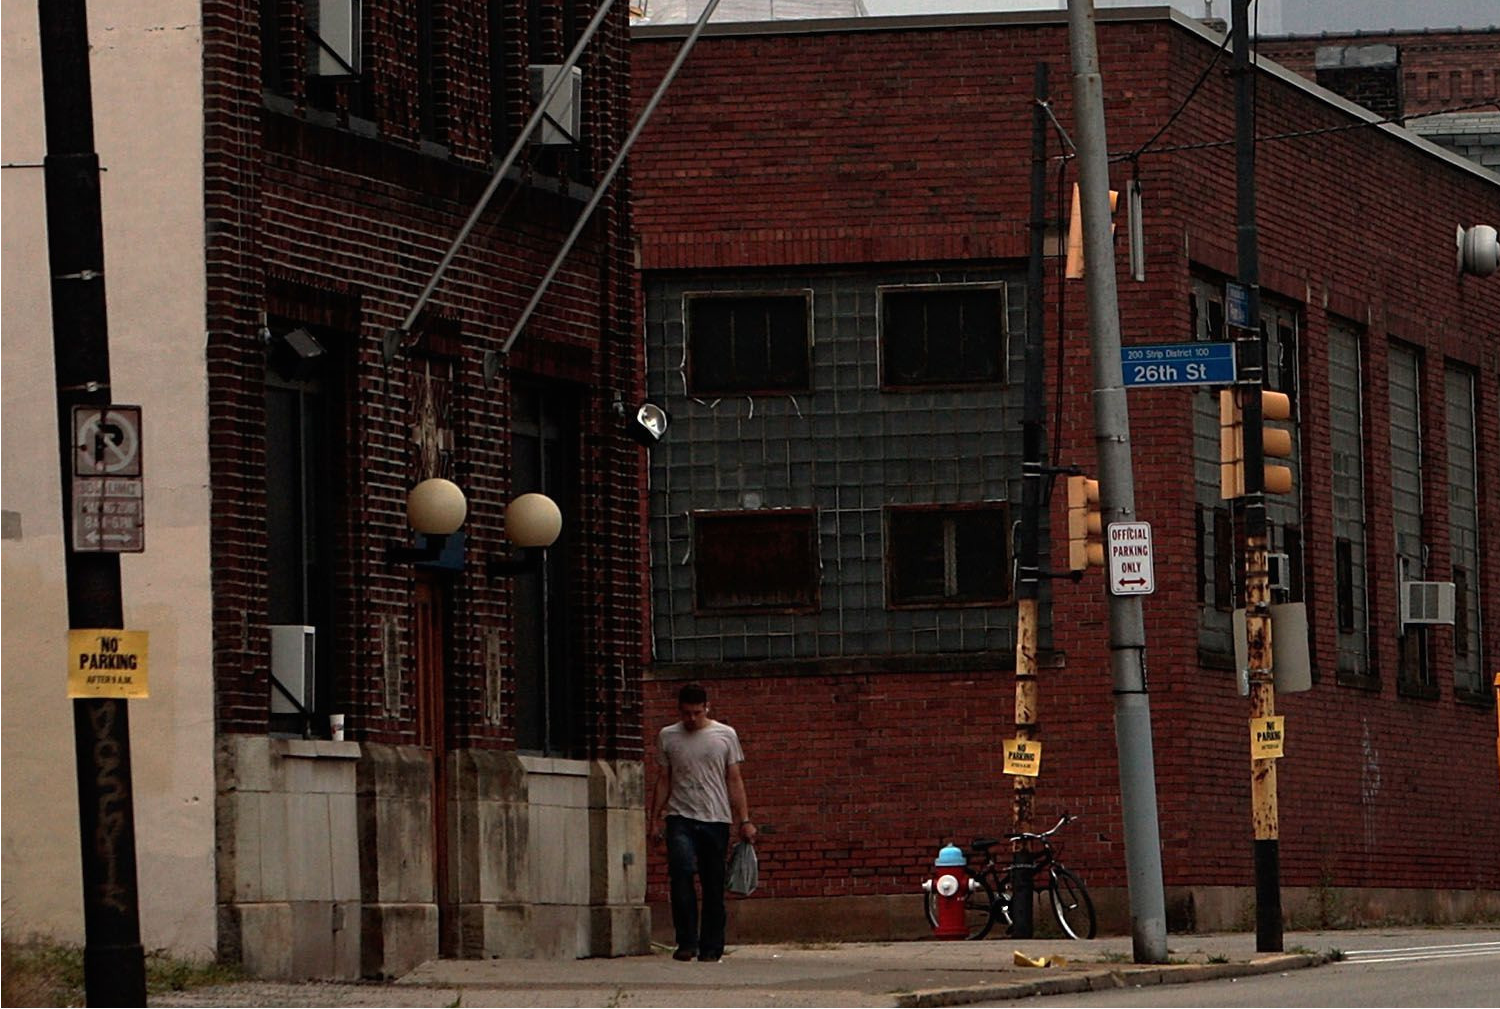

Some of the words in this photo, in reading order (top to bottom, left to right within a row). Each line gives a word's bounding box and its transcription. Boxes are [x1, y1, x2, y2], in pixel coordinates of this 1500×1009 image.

[1128, 350, 1143, 359] 200
[1146, 350, 1164, 360] Strip
[1166, 349, 1192, 358] District
[1134, 365, 1177, 382] 26th
[1186, 363, 1207, 380] St
[1111, 529, 1148, 541] OFFICIAL
[1113, 545, 1149, 557] PARKING
[1121, 562, 1142, 573] ONLY
[101, 637, 118, 653] NO
[79, 654, 137, 670] PARKING
